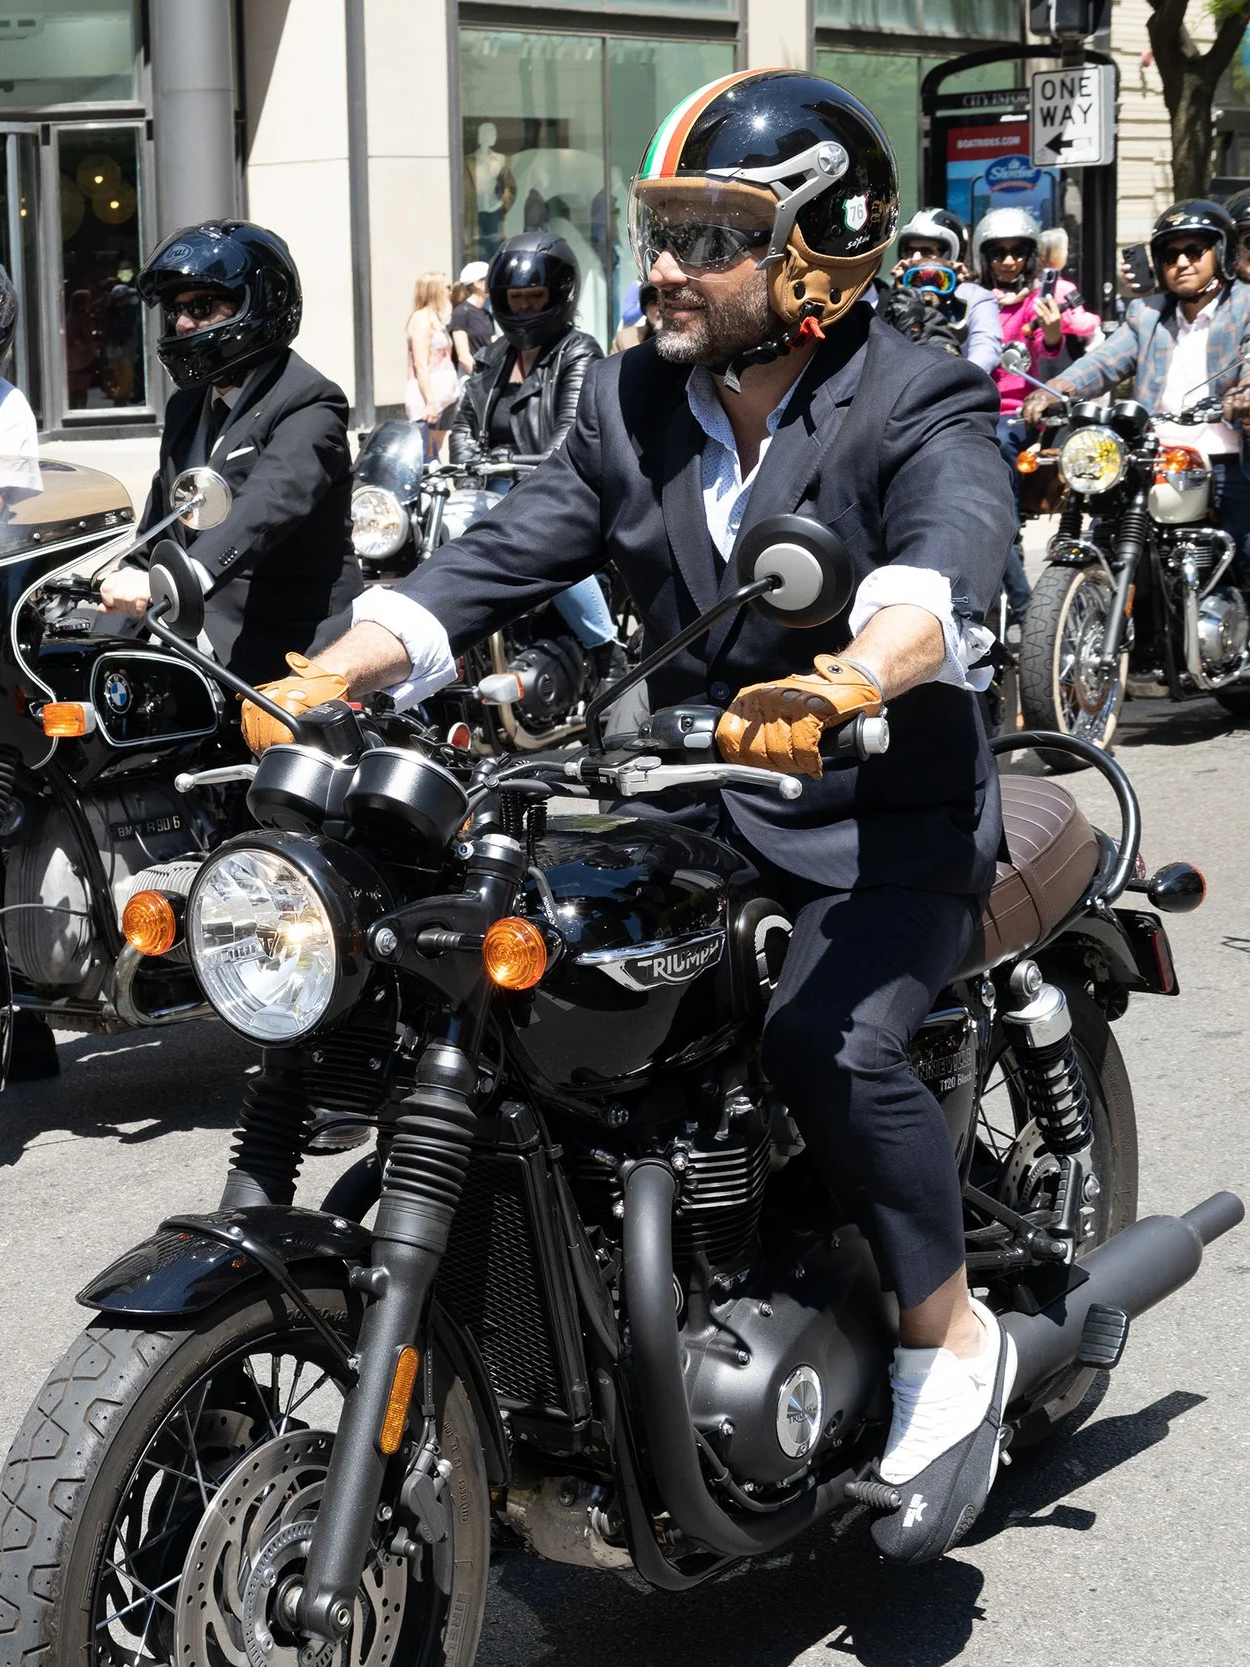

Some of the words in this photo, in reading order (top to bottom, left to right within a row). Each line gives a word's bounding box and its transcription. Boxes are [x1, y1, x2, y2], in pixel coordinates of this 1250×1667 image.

[962, 93, 989, 107] CITY
[1040, 77, 1092, 101] ONE
[1040, 103, 1093, 127] WAY
[850, 203, 864, 222] 76
[637, 939, 720, 981] TRIUMPH
